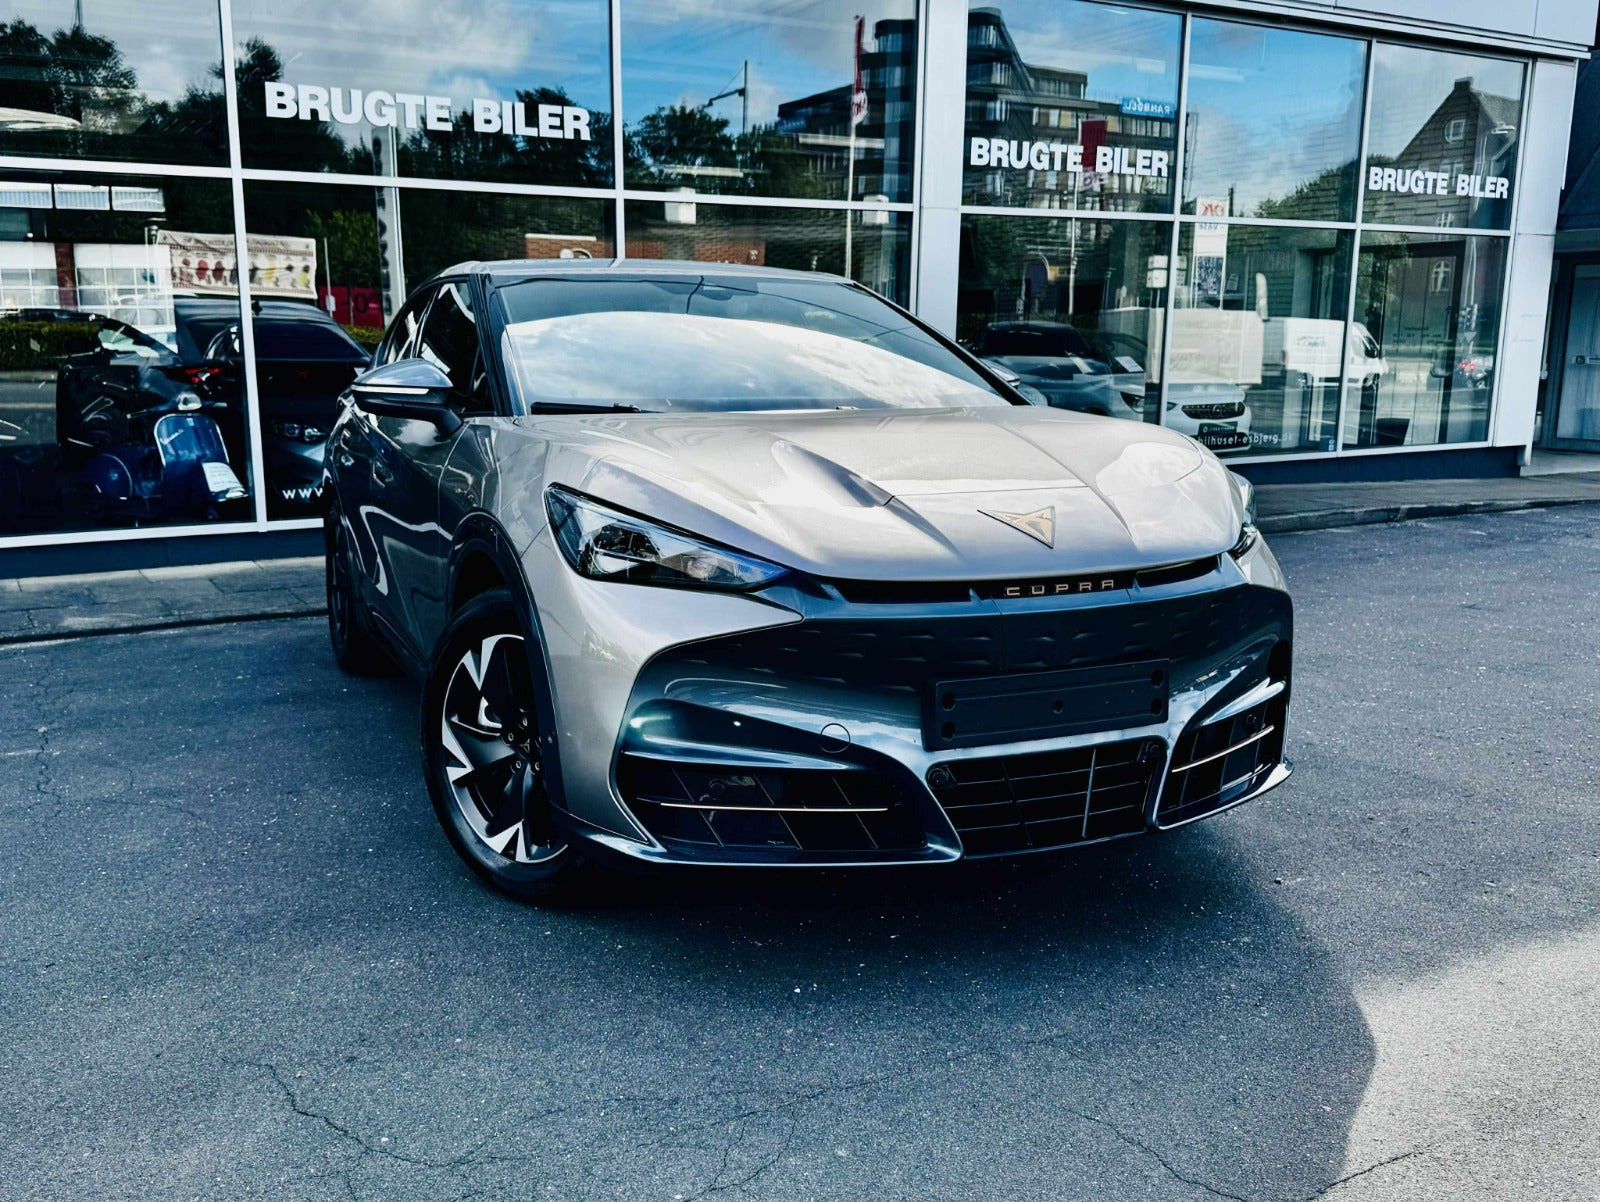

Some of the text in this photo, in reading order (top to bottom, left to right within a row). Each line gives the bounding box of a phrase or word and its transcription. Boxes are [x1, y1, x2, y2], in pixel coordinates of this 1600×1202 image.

[264, 81, 591, 141] BRUGTE BILER
[970, 137, 1169, 177] BRUGTE BILER
[1368, 166, 1510, 199] BRUGTE BILER
[1005, 579, 1115, 597] CUPRA
